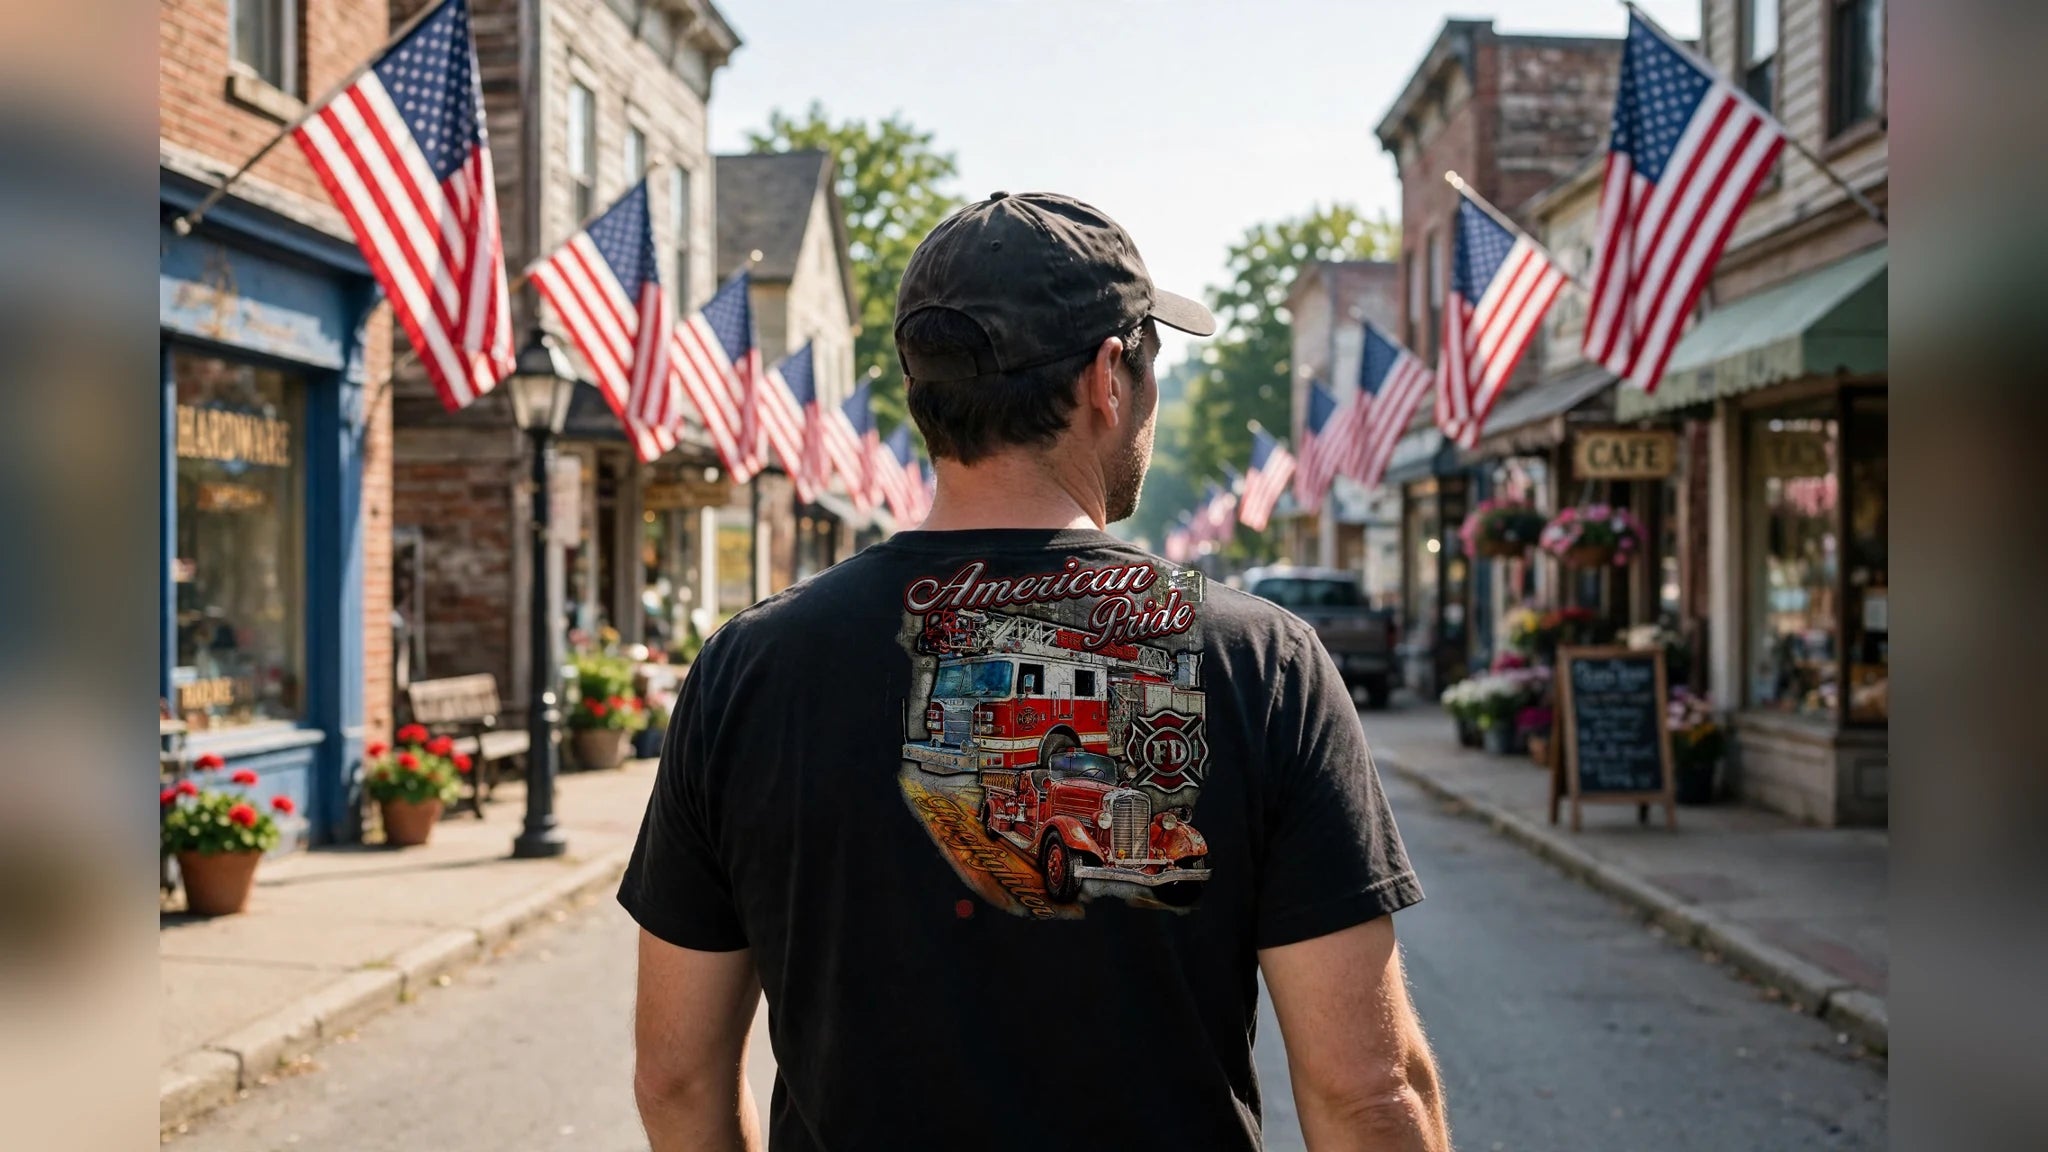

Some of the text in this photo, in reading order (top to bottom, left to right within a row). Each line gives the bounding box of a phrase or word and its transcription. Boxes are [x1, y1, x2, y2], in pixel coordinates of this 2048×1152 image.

[177, 405, 290, 467] HARDWARE
[1587, 438, 1660, 471] CAFE
[905, 559, 1156, 612] American
[1082, 589, 1194, 648] Pride
[1152, 739, 1187, 764] FD
[915, 796, 1055, 917] Firefighter
